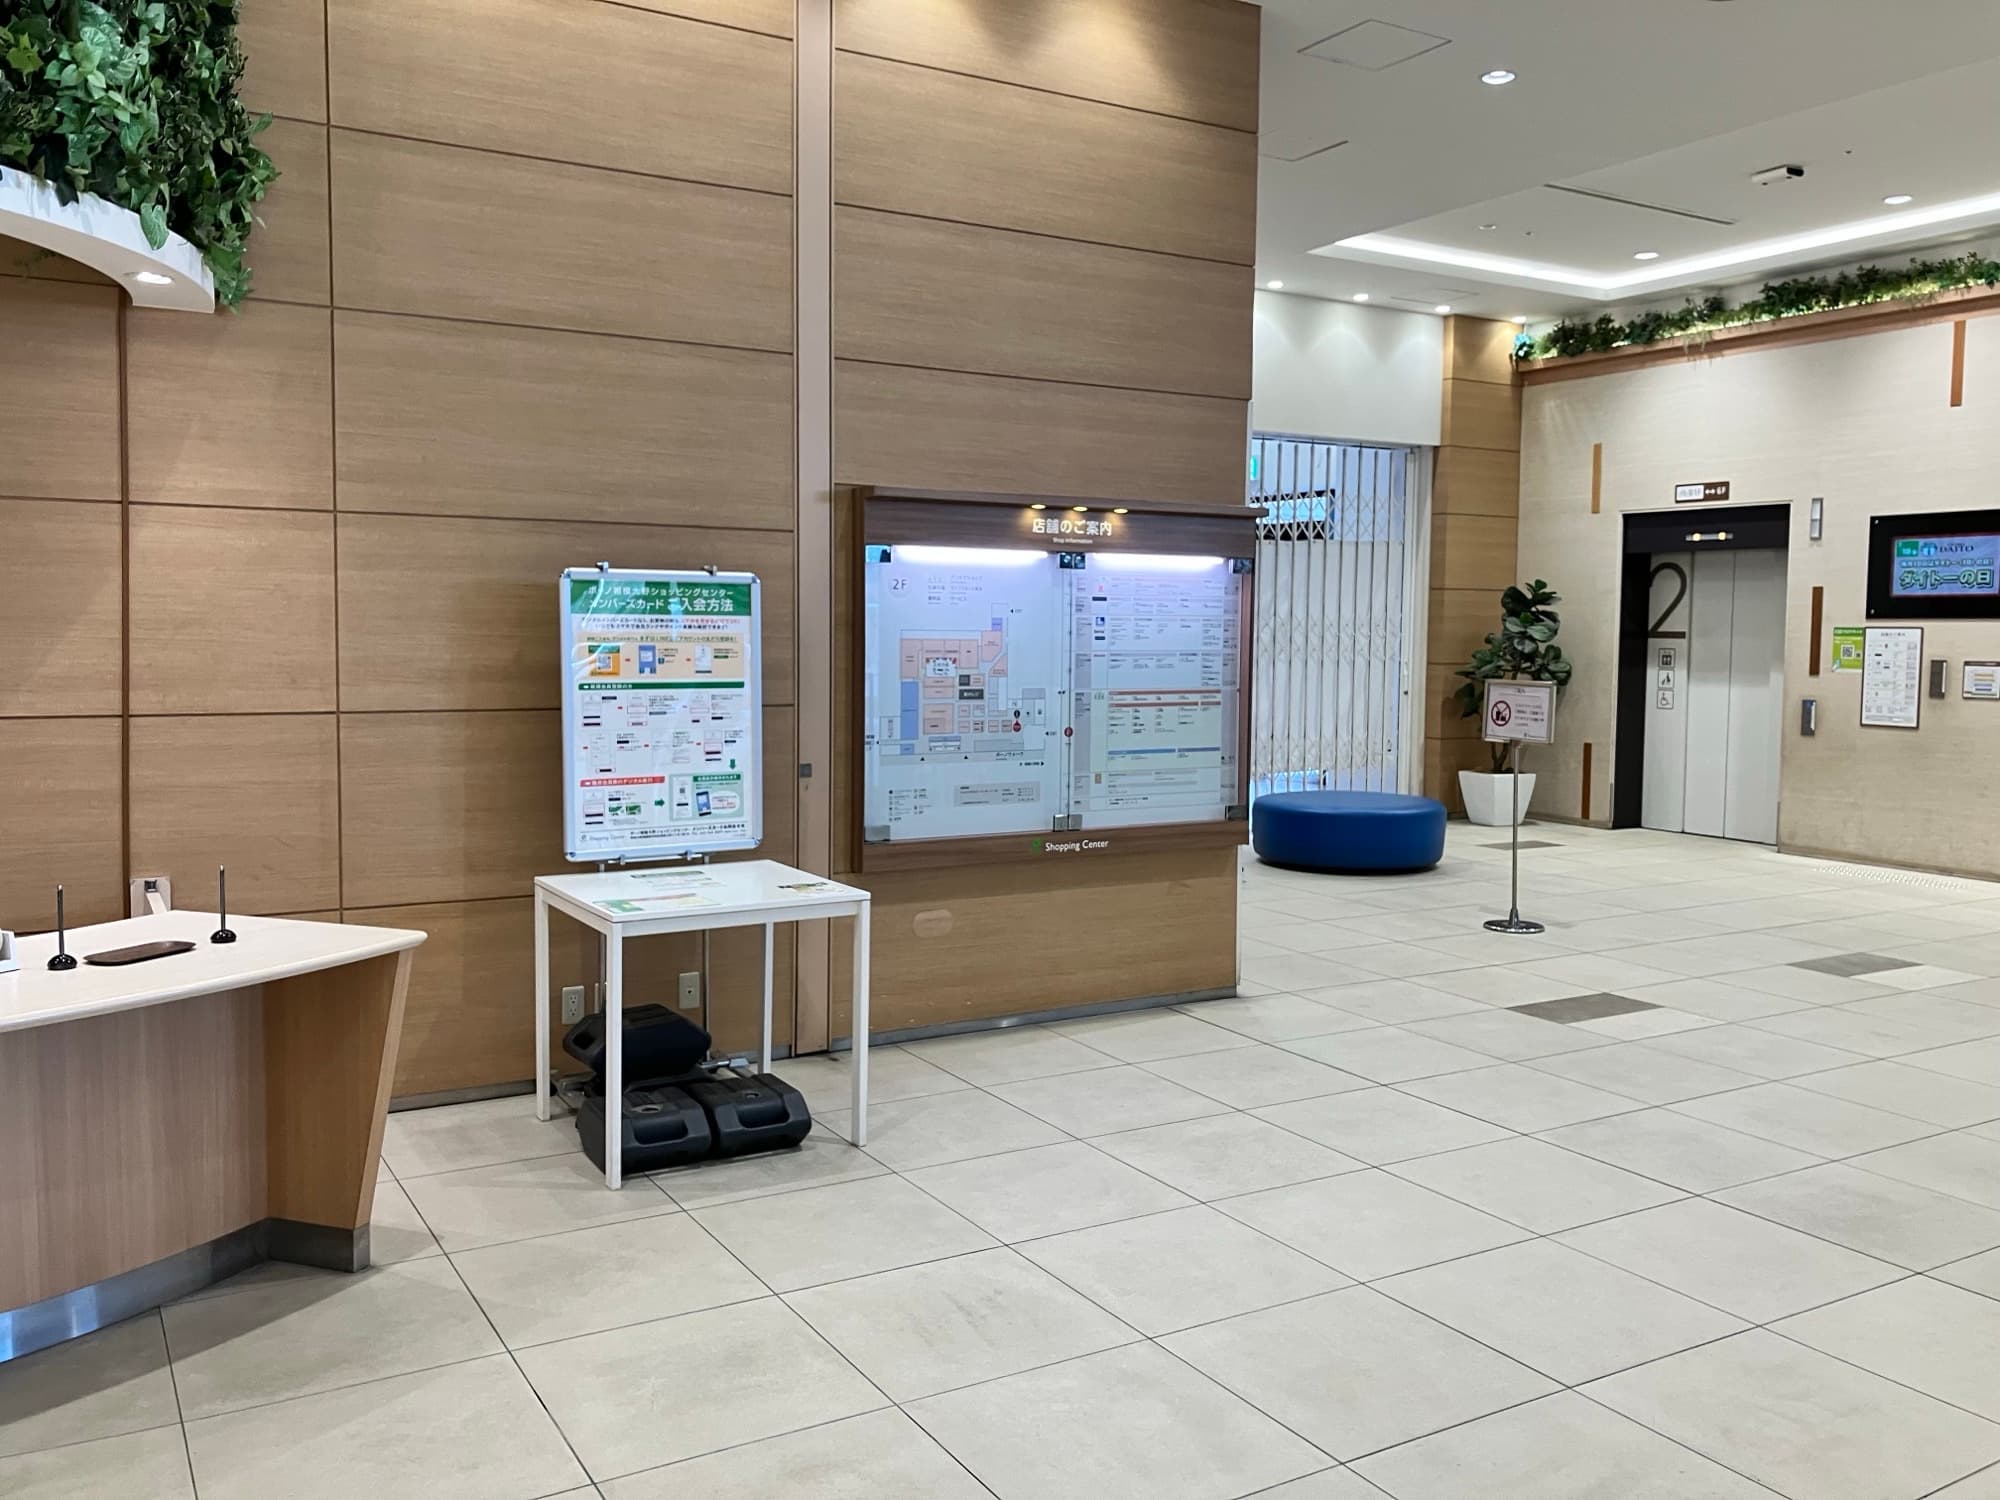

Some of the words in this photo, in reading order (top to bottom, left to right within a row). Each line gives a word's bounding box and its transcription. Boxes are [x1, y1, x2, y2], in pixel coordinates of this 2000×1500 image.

[1032, 518, 1113, 536] 店舗のご案内
[892, 578, 908, 590] 2F
[1899, 568, 1994, 590] ダイトーの日
[1647, 561, 1688, 639] 2
[1045, 842, 1081, 853] Shopping
[1082, 839, 1109, 849] Center
